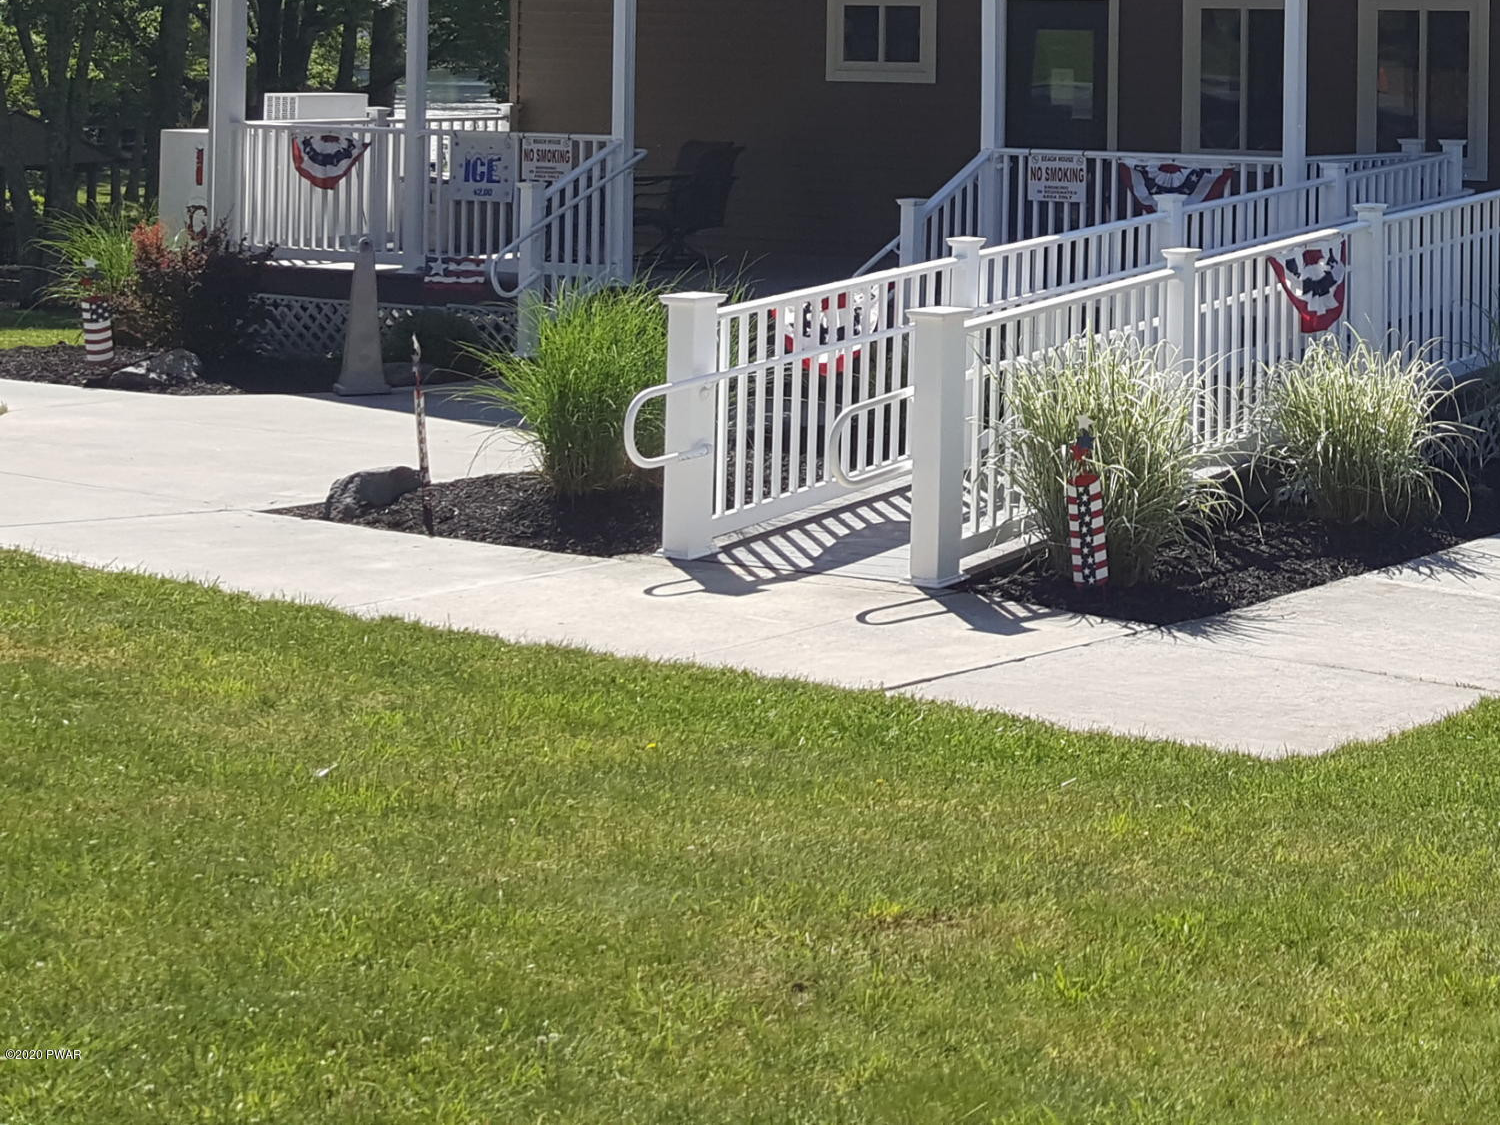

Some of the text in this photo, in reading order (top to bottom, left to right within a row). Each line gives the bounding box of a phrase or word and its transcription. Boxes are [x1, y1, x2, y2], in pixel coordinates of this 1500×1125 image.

[523, 147, 571, 164] NO SMOKING
[464, 152, 502, 183] ICE
[1030, 166, 1085, 183] NO SMOKING
